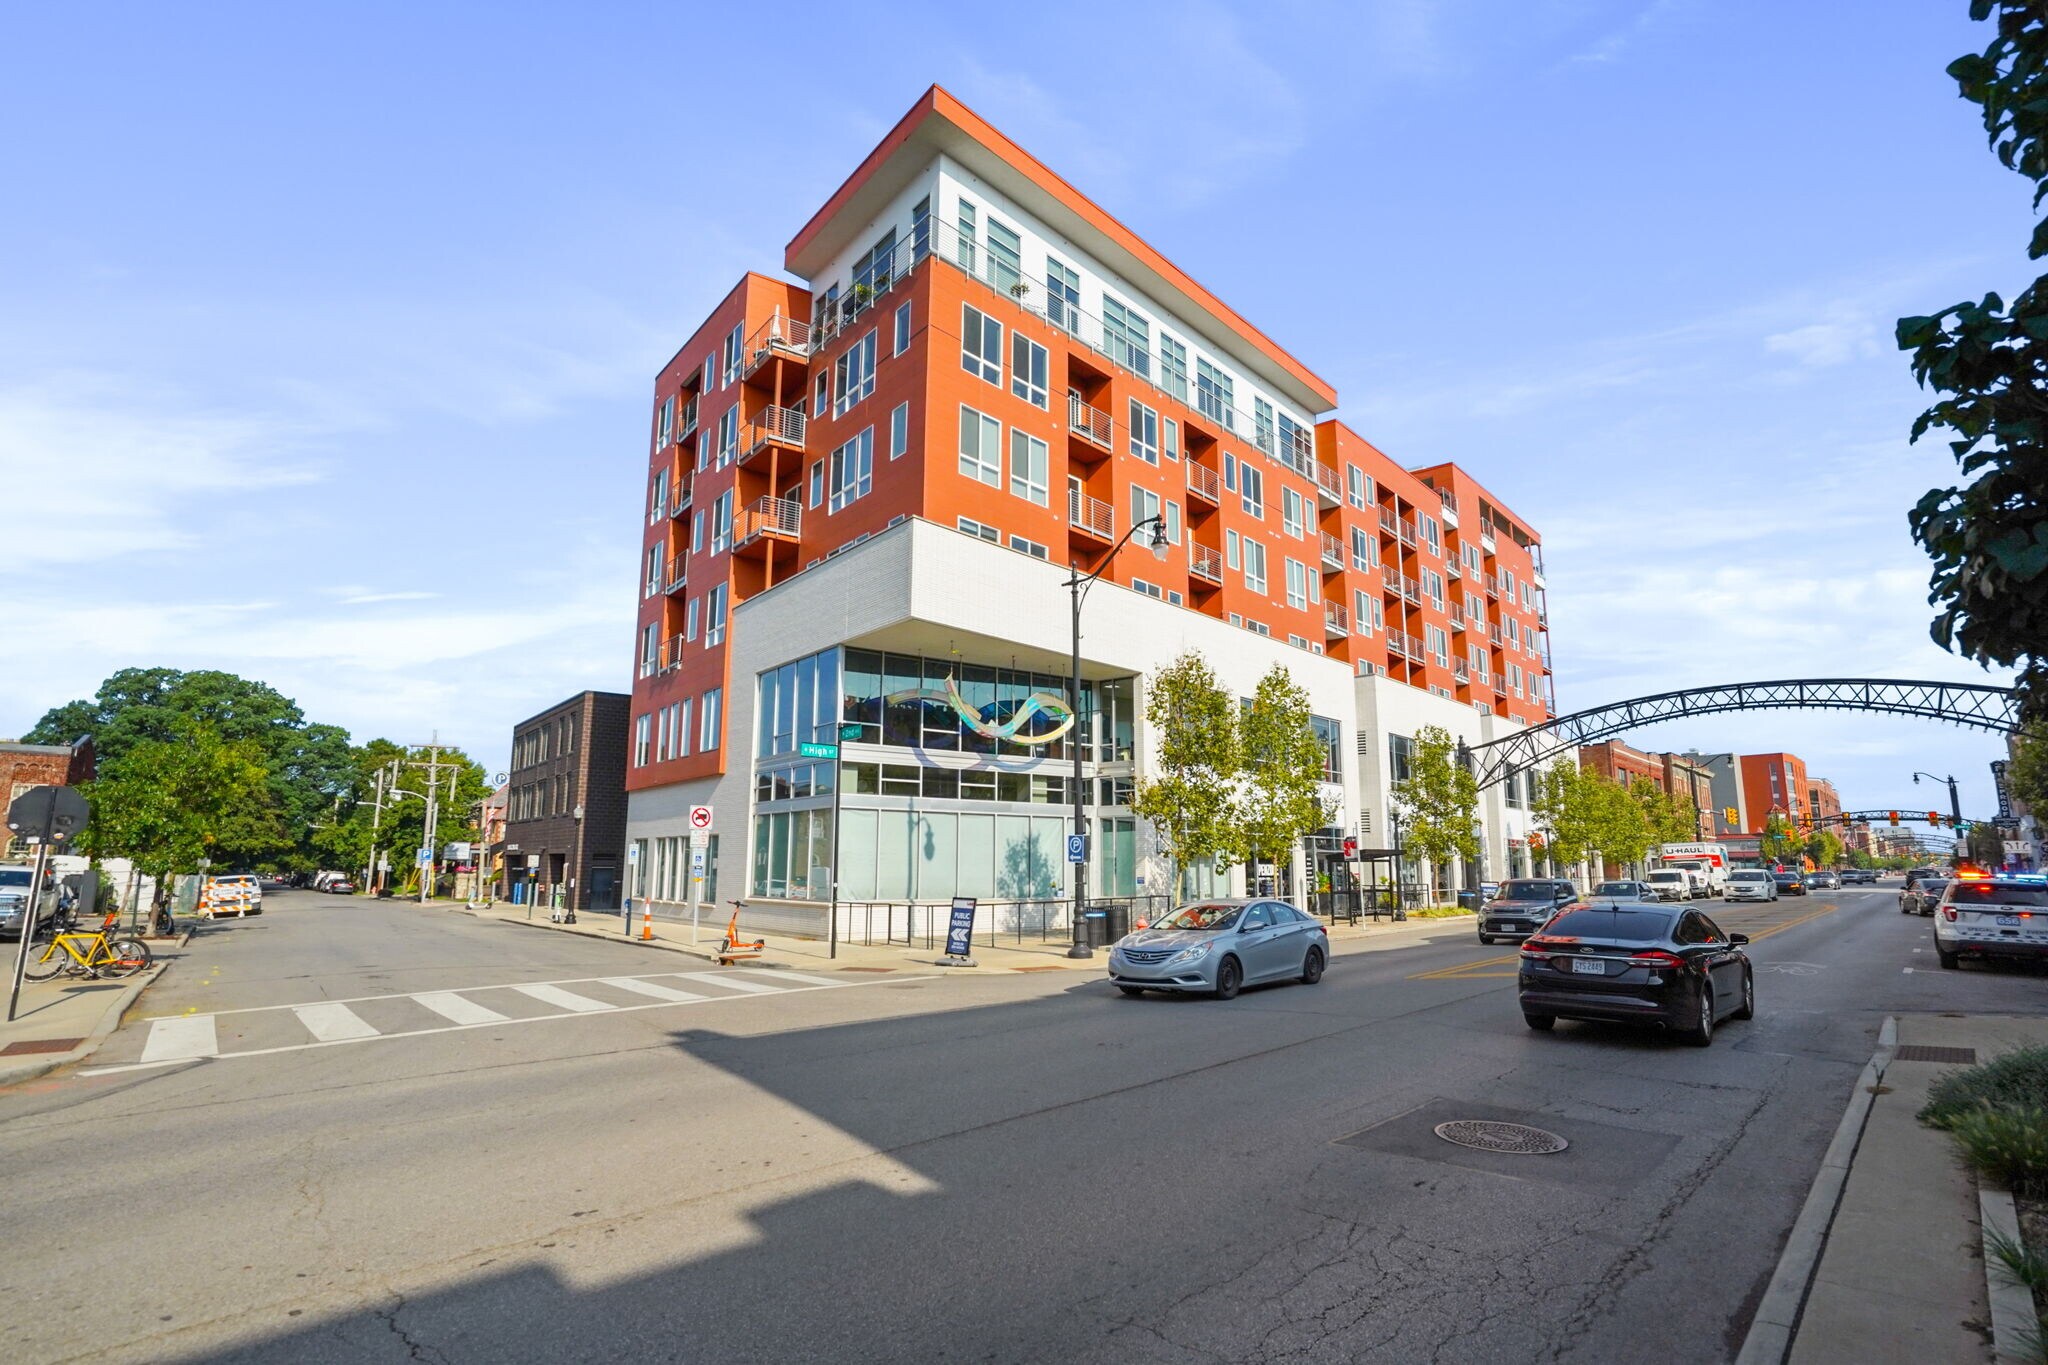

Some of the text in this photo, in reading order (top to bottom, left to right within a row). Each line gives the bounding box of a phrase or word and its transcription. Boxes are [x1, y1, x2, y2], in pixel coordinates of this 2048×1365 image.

[809, 746, 828, 757] High
[954, 912, 971, 920] PUBLIC
[951, 920, 971, 928] PARKING
